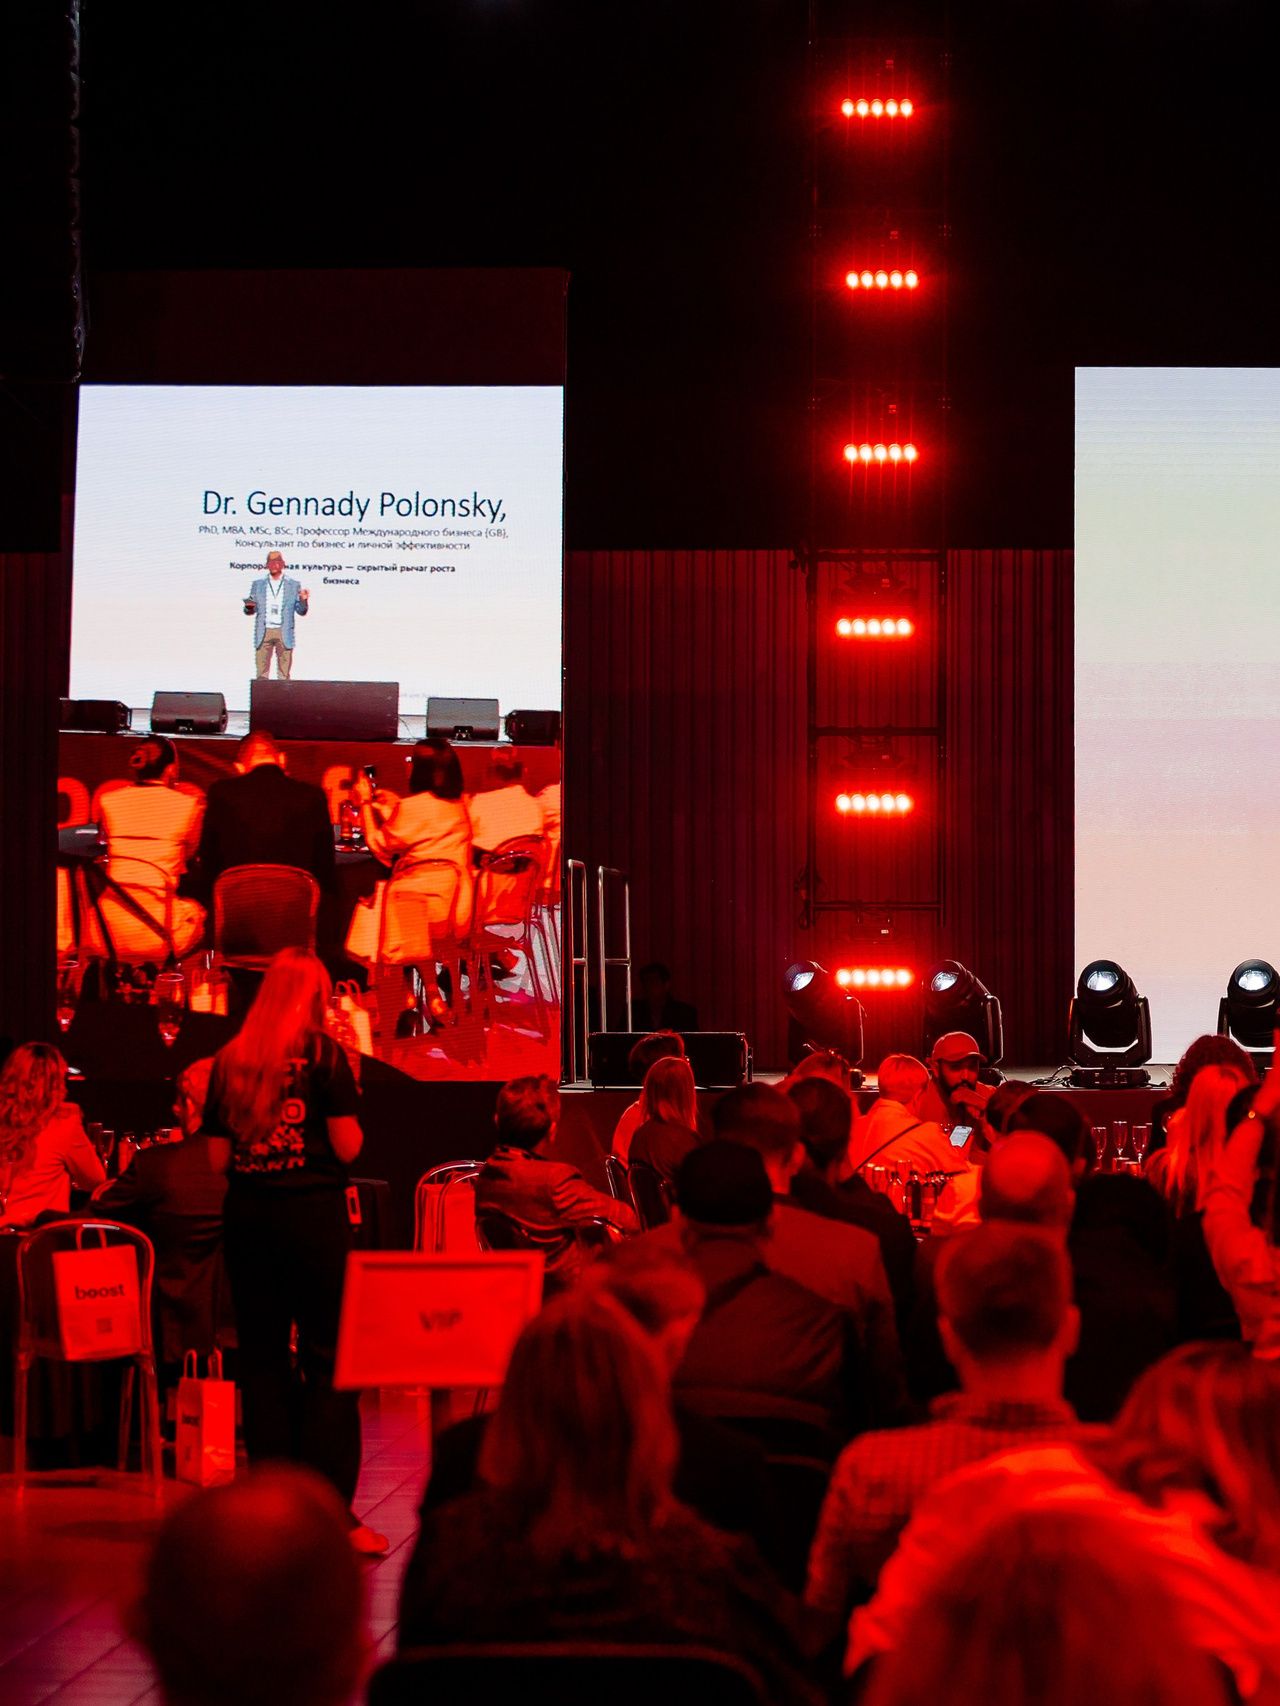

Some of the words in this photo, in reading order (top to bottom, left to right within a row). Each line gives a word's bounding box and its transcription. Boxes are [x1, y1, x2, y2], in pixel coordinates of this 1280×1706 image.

[202, 489, 237, 515] Dr.
[246, 489, 371, 524] Gennady
[379, 490, 507, 525] Polonsky,
[198, 524, 220, 537] PhD,
[248, 525, 273, 537] MSc,
[295, 525, 351, 538] Профессор
[352, 527, 441, 539] Международного
[441, 527, 483, 538] бизнеса
[234, 538, 295, 550] Консультант
[296, 541, 310, 549] по
[311, 538, 347, 549] бизнес
[347, 541, 355, 549] и
[356, 539, 394, 550] личной
[395, 540, 471, 552] эффективности
[301, 563, 343, 574] культура
[356, 562, 398, 574] скрытый
[399, 565, 428, 575] рычаг
[429, 565, 456, 575] роста
[322, 576, 360, 586] бизнеса
[74, 1282, 125, 1300] boost
[418, 1308, 464, 1332] VIP
